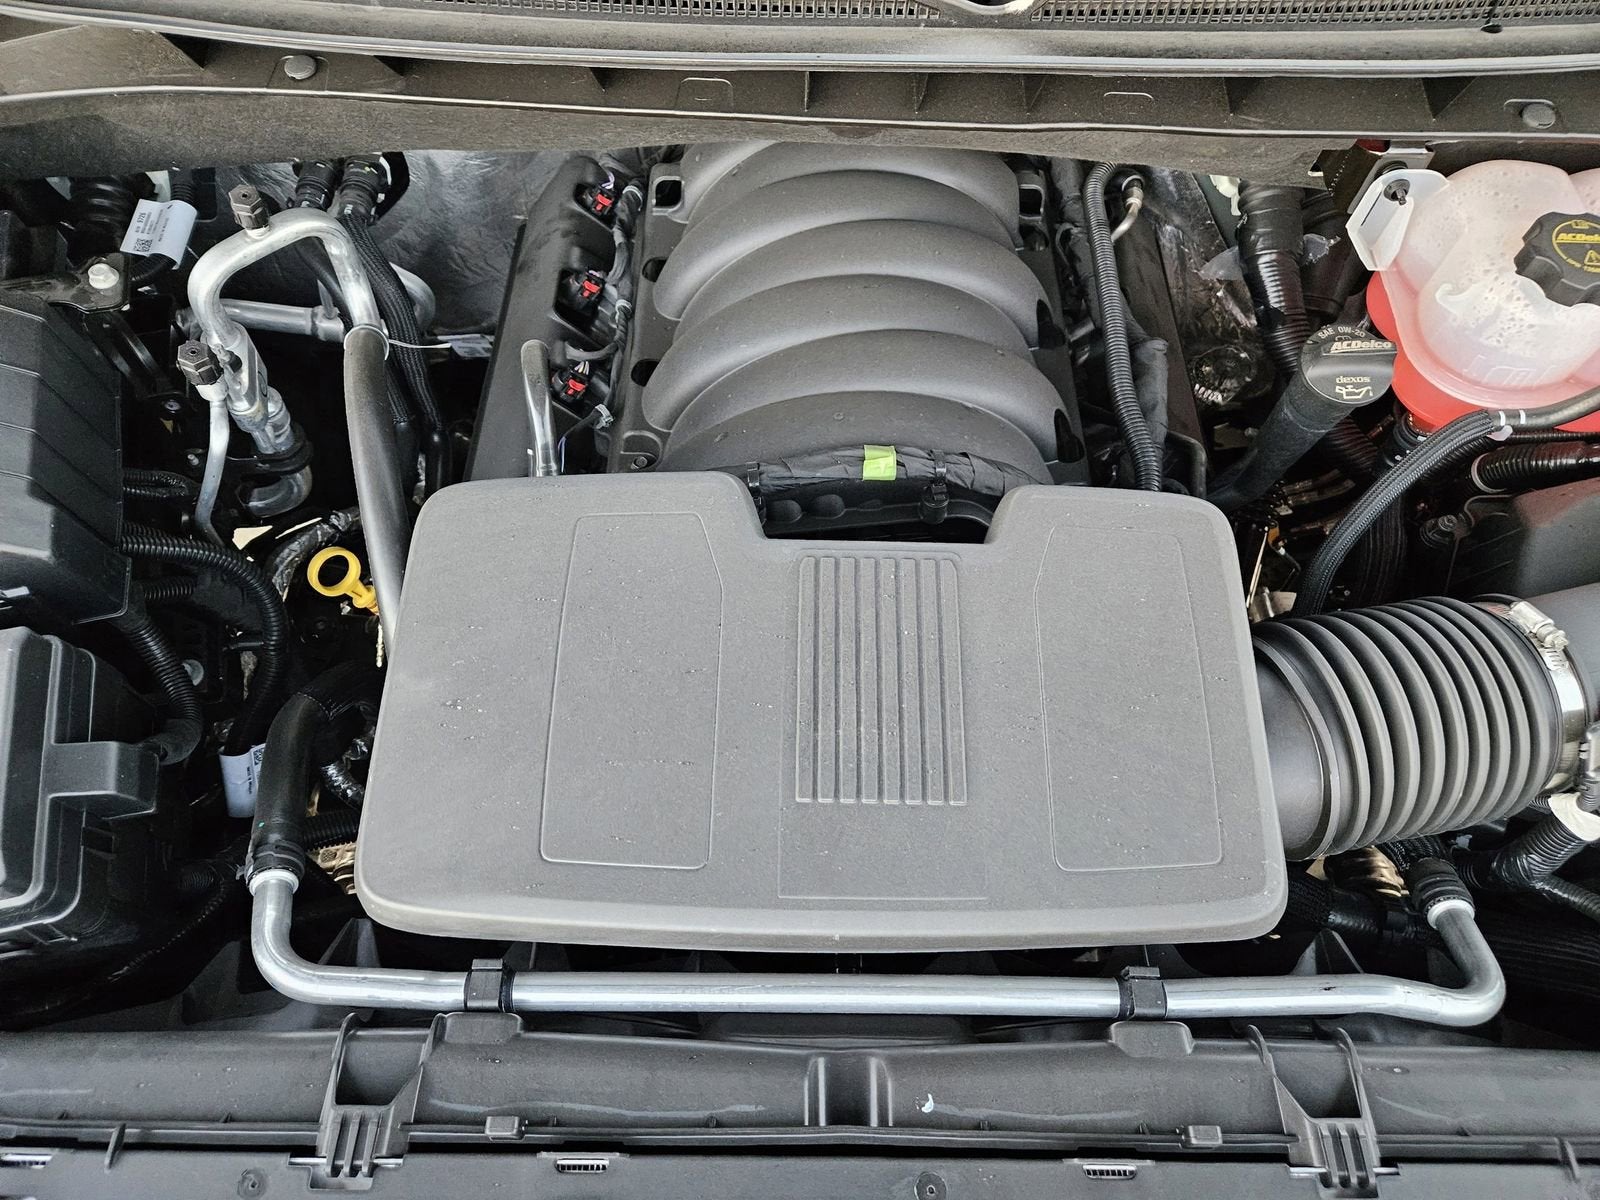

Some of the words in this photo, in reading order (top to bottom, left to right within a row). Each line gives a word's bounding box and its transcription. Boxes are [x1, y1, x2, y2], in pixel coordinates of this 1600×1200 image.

[1318, 327, 1335, 339] SAE
[1337, 326, 1366, 338] 0W-20
[1330, 340, 1392, 351] ACDelco
[1335, 376, 1371, 384] dexos
